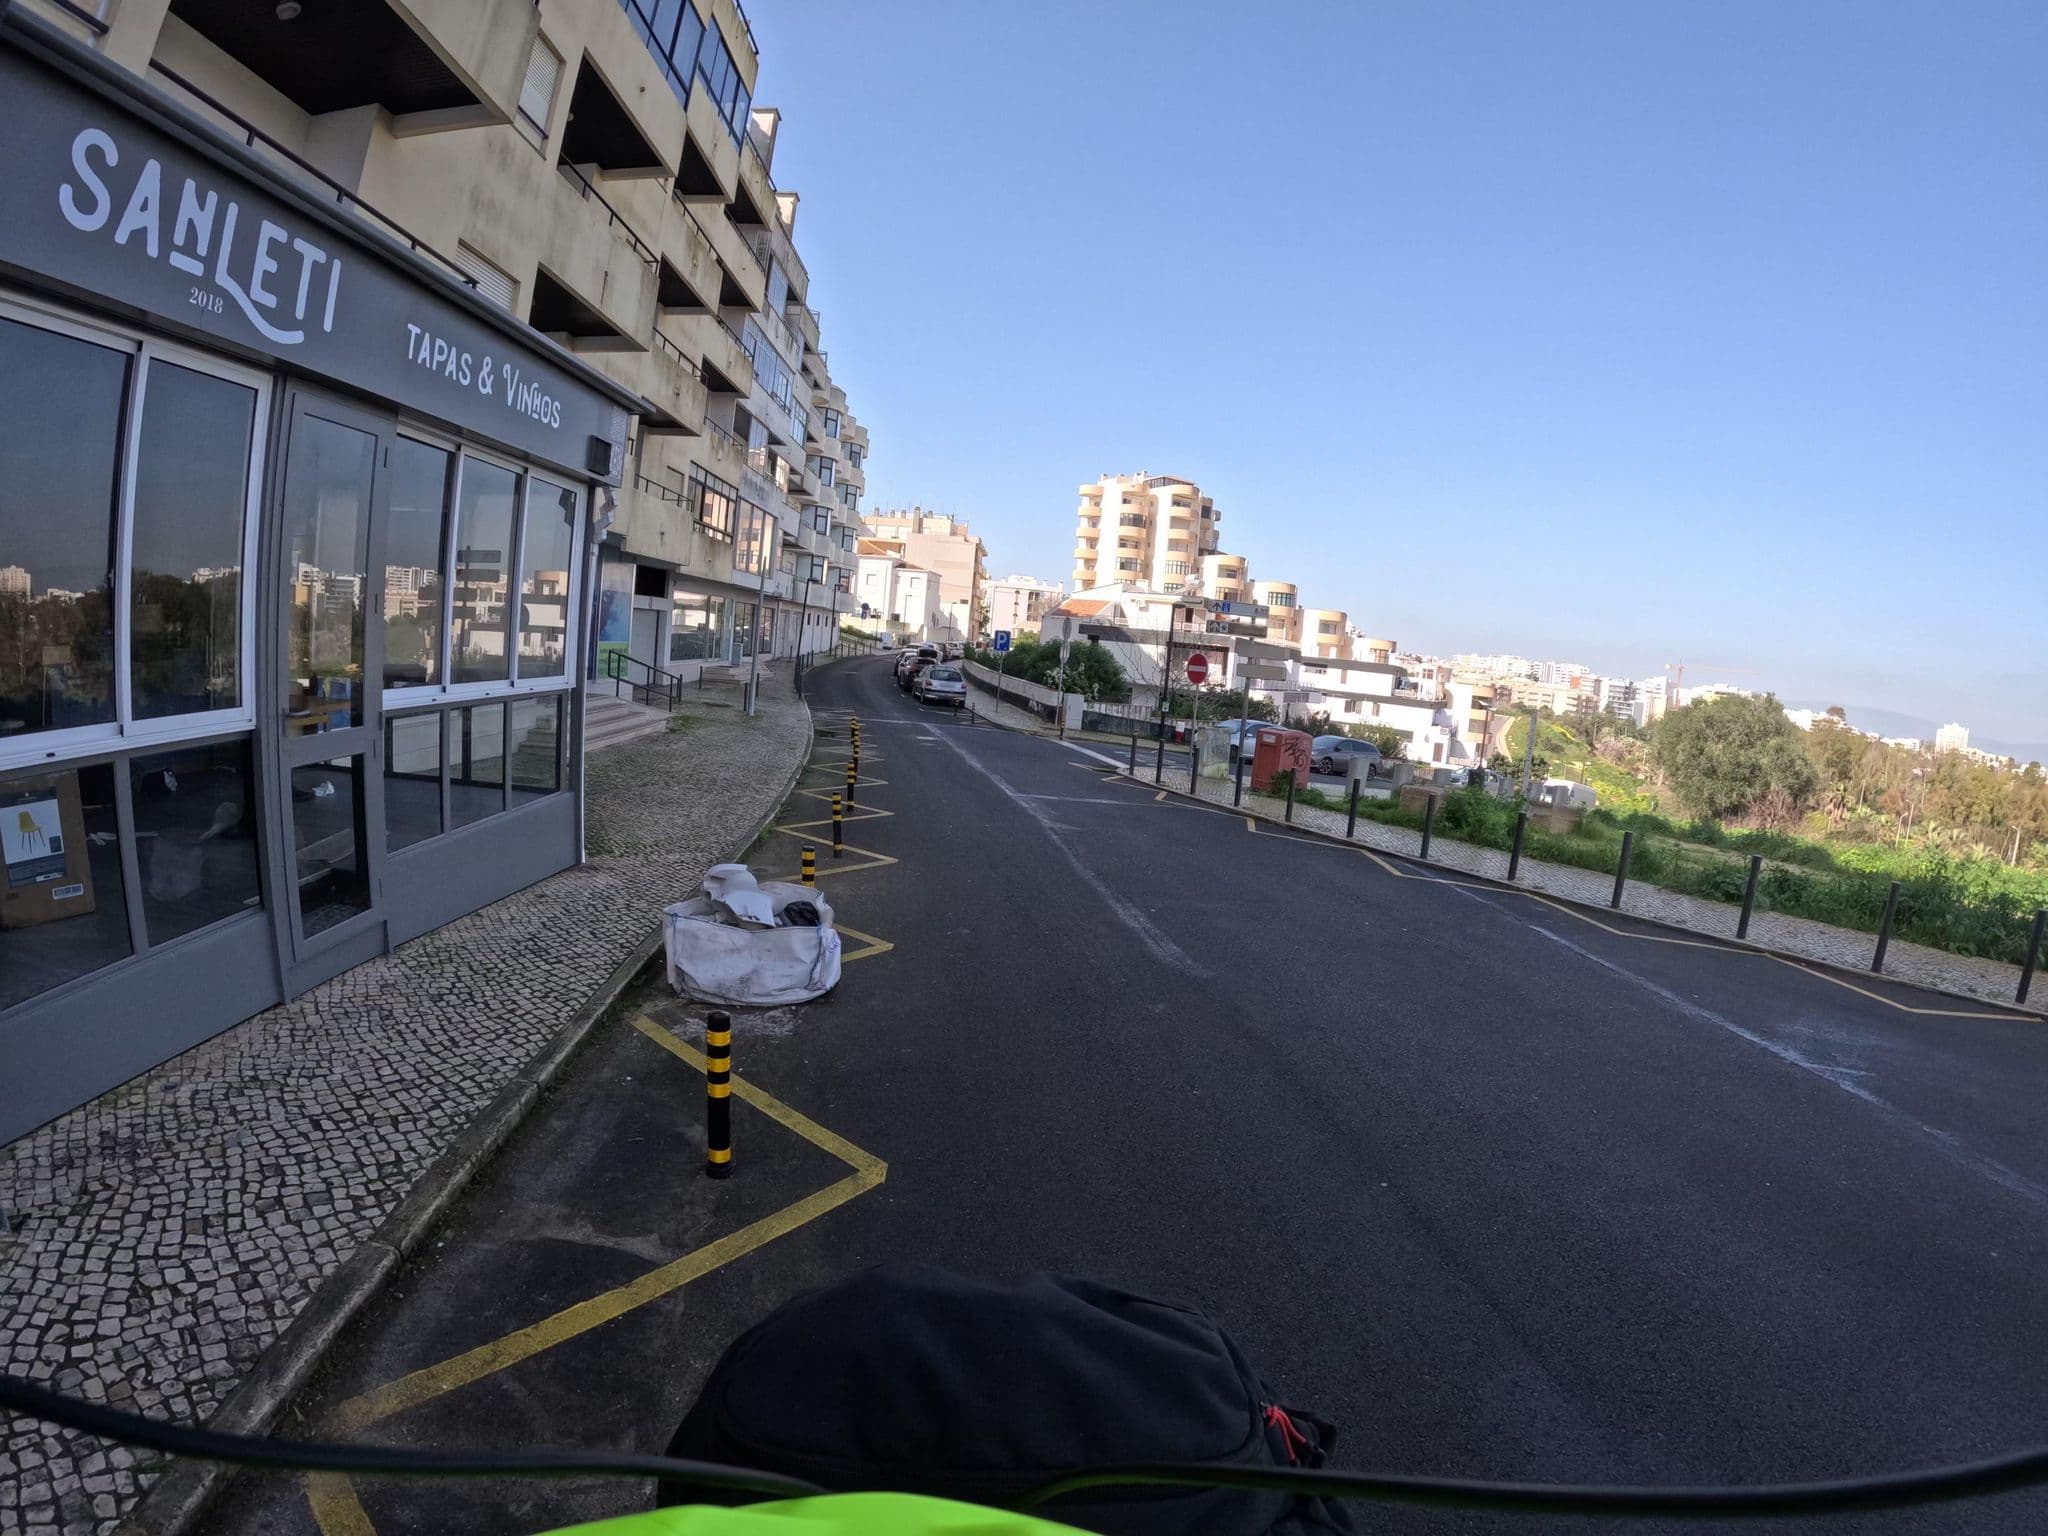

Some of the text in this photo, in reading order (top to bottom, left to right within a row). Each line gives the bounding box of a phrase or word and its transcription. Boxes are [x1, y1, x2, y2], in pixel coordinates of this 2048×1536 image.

[59, 128, 342, 345] SANLETI
[189, 287, 223, 314] 2018
[407, 323, 472, 386] TAPAS
[478, 356, 494, 395] &
[996, 631, 1007, 649] P
